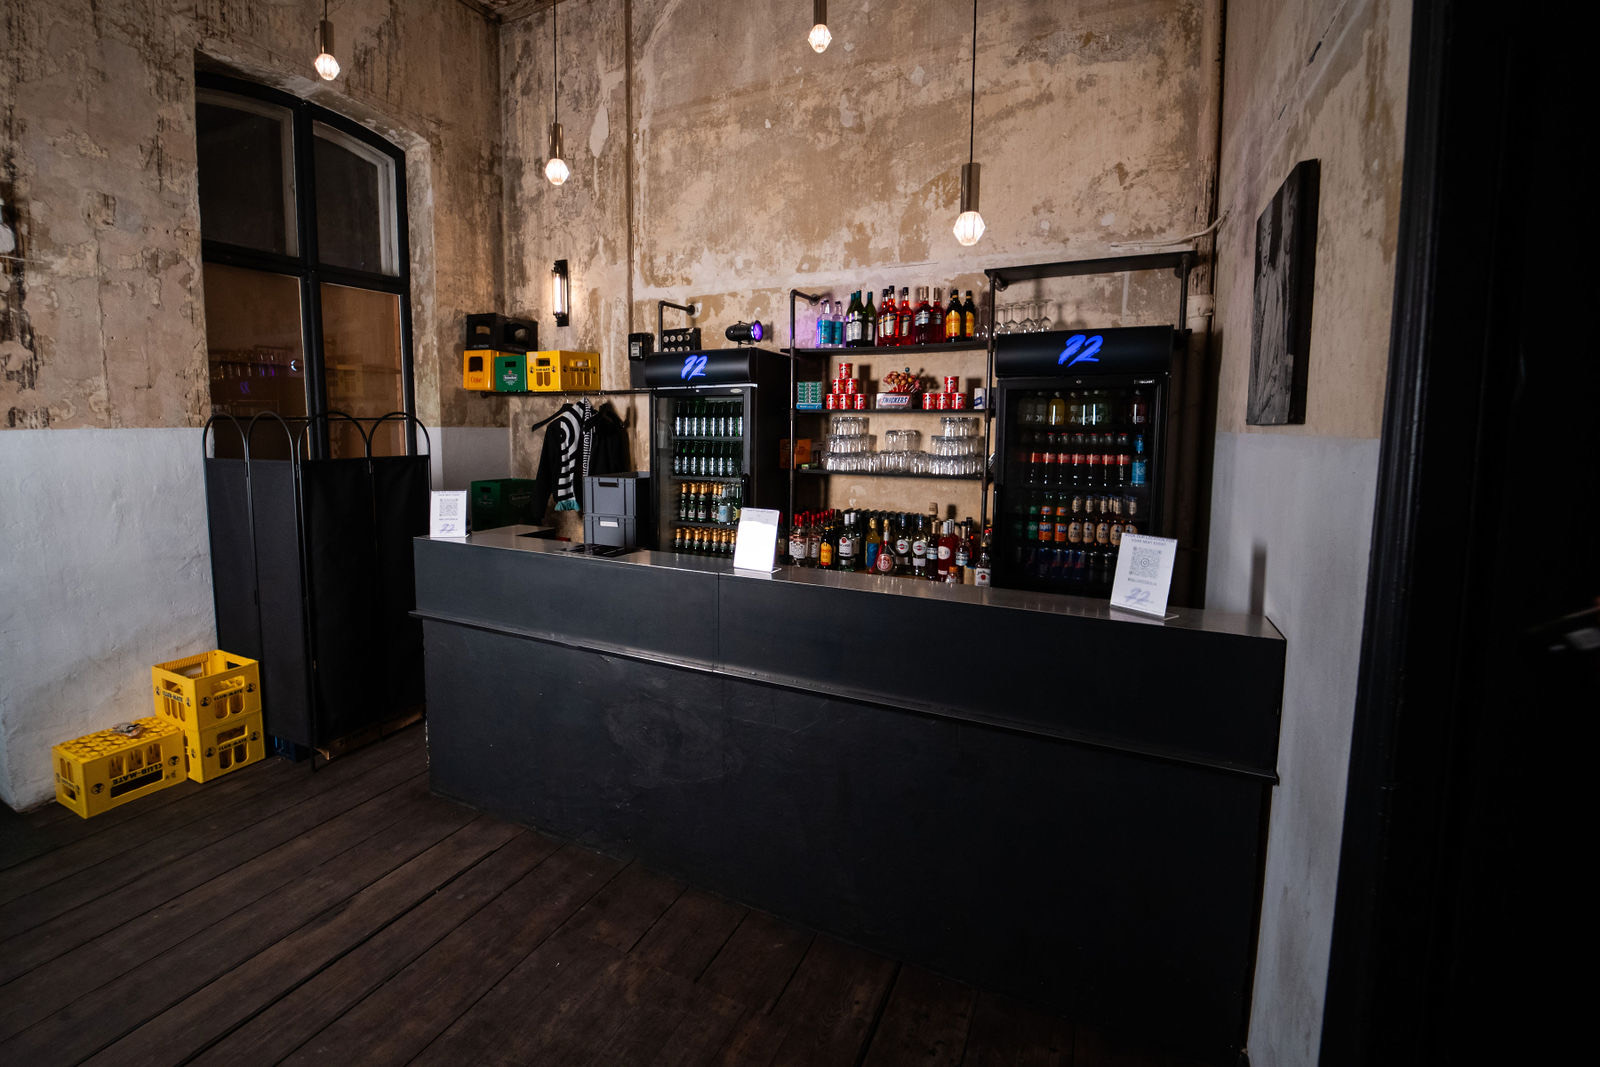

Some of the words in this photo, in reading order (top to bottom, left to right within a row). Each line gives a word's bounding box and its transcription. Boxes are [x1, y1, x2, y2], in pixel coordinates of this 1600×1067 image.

[1058, 334, 1104, 368] 22
[881, 396, 909, 404] SNICKERS
[112, 763, 163, 785] CLUB-MATE
